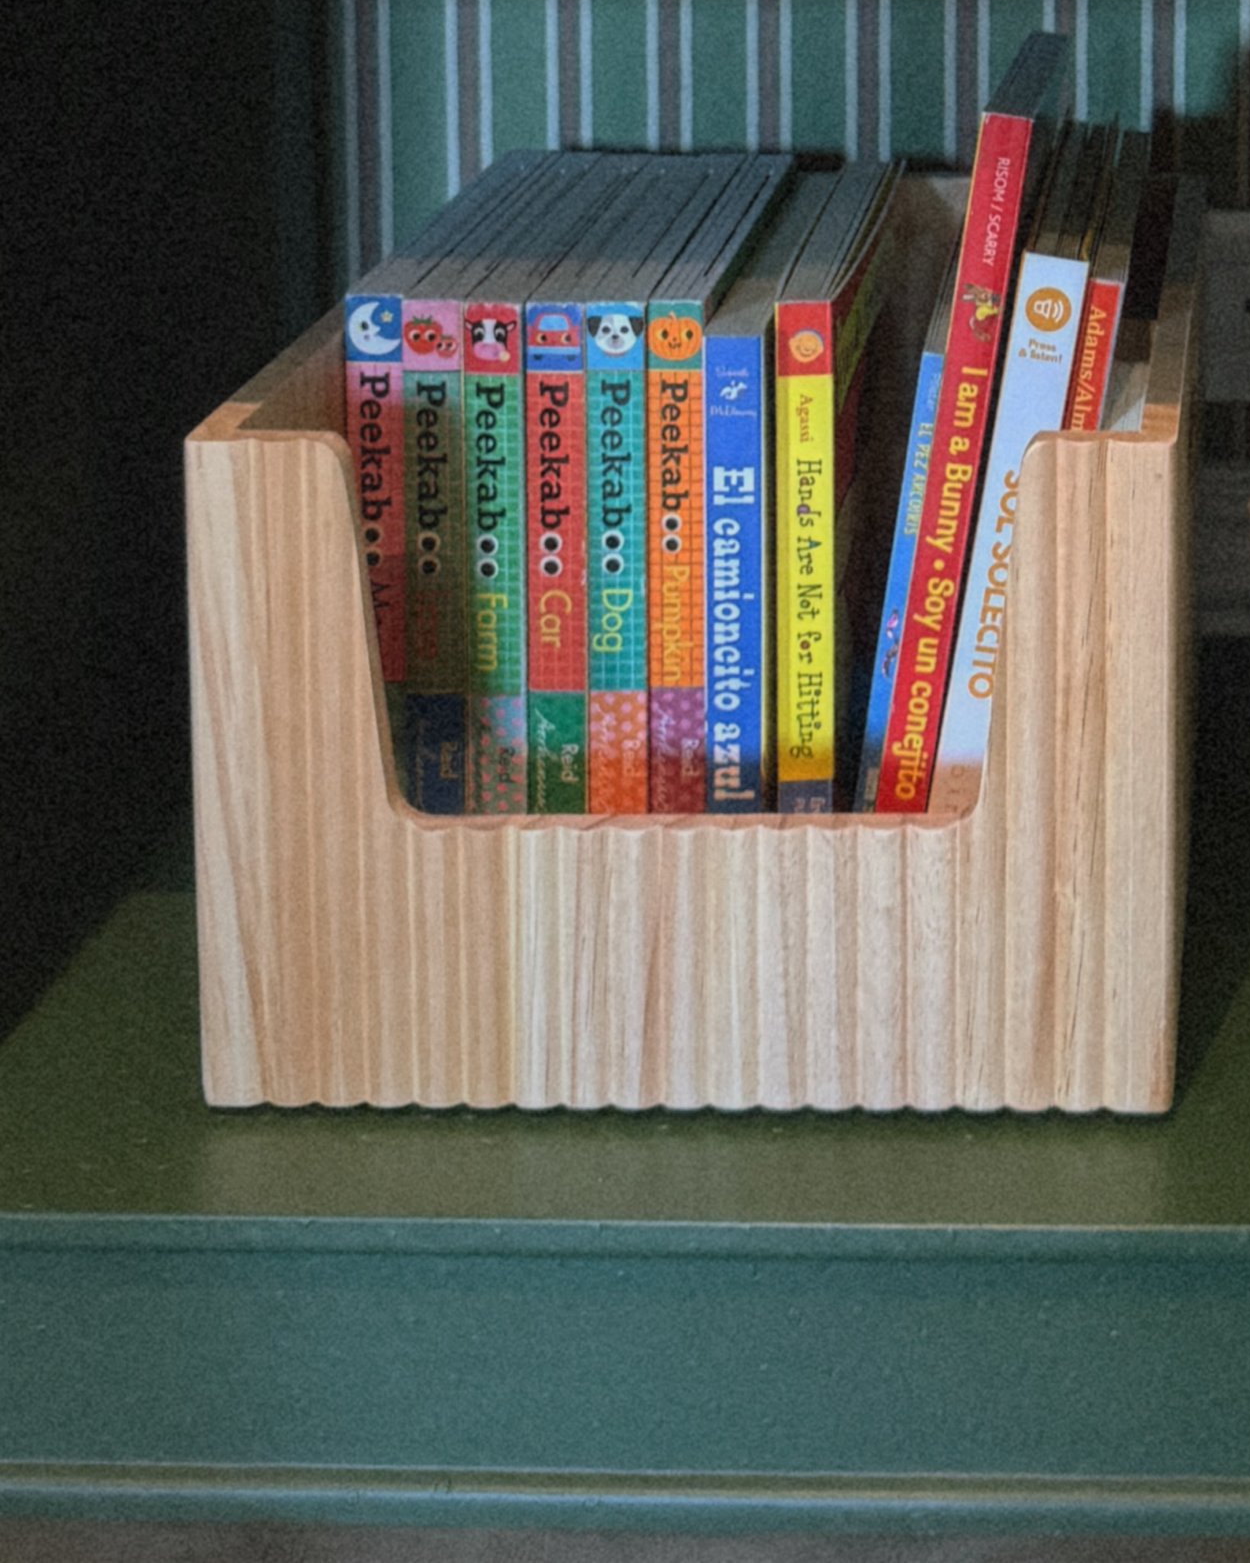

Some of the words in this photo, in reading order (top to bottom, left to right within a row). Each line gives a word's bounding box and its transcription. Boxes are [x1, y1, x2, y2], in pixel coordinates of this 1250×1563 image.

[992, 157, 1010, 201] RISOM
[983, 215, 1000, 268] SCARRY
[963, 367, 987, 377] I
[799, 394, 814, 442] Agassi
[954, 383, 978, 426] am
[949, 436, 970, 453] a
[714, 466, 755, 504] El
[798, 458, 821, 526] Hands
[926, 462, 973, 552] Bunny
[799, 536, 822, 574] Are
[541, 589, 571, 647] Car
[592, 587, 632, 652] Dog
[655, 565, 693, 681] Pumpkin
[712, 518, 754, 711] camioncito
[799, 583, 821, 619] Not
[913, 578, 954, 629] Soy
[969, 541, 1013, 699] SOLECITO
[476, 590, 507, 671] Farm
[799, 630, 821, 664] for
[916, 638, 940, 673] un
[792, 672, 822, 757] Hitting
[892, 681, 931, 799] conejito
[562, 743, 578, 781] Reid
[714, 722, 753, 801] azul
